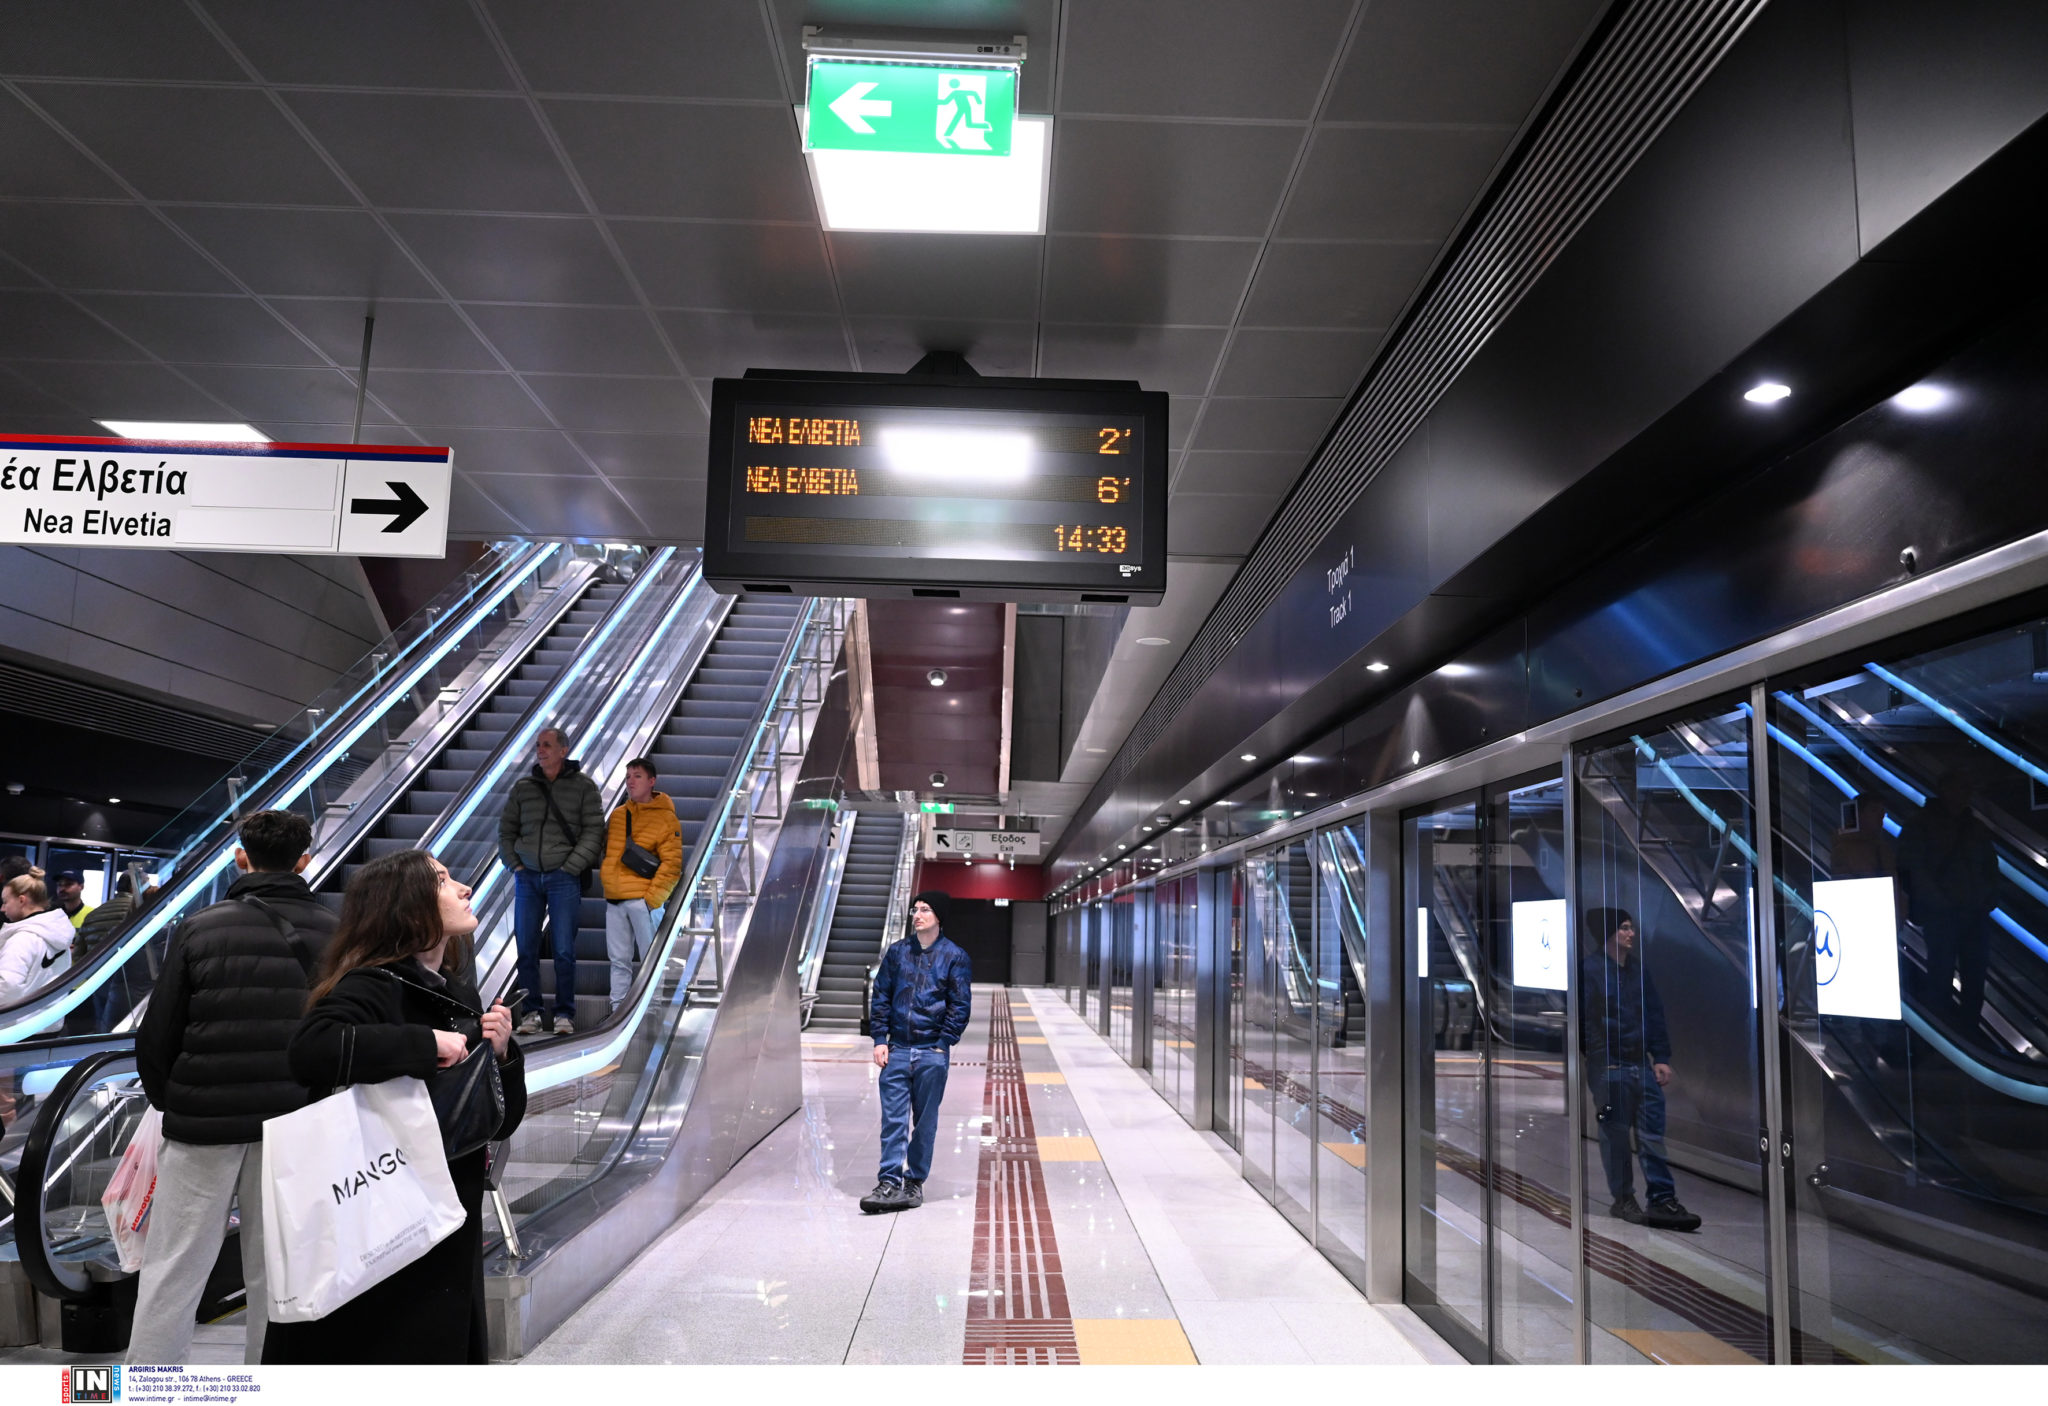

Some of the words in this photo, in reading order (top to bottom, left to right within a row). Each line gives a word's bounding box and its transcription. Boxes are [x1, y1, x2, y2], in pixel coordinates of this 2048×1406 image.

[749, 417, 782, 444] ΝΕΑ
[789, 418, 860, 446] ΕΛΒΕΤΙΑ
[0, 457, 40, 490] έα
[52, 458, 188, 501] Ελβετία
[746, 466, 780, 493] ΝΕΑ
[786, 467, 858, 495] ΕΛΒΕΤΙΑ
[24, 508, 73, 534] Nea
[83, 509, 171, 537] Elvetia
[1054, 524, 1126, 553] 14:33
[1327, 551, 1349, 595] Τροχιά
[1350, 545, 1354, 568] 1
[1329, 596, 1347, 628] Track
[1348, 590, 1352, 612] 1
